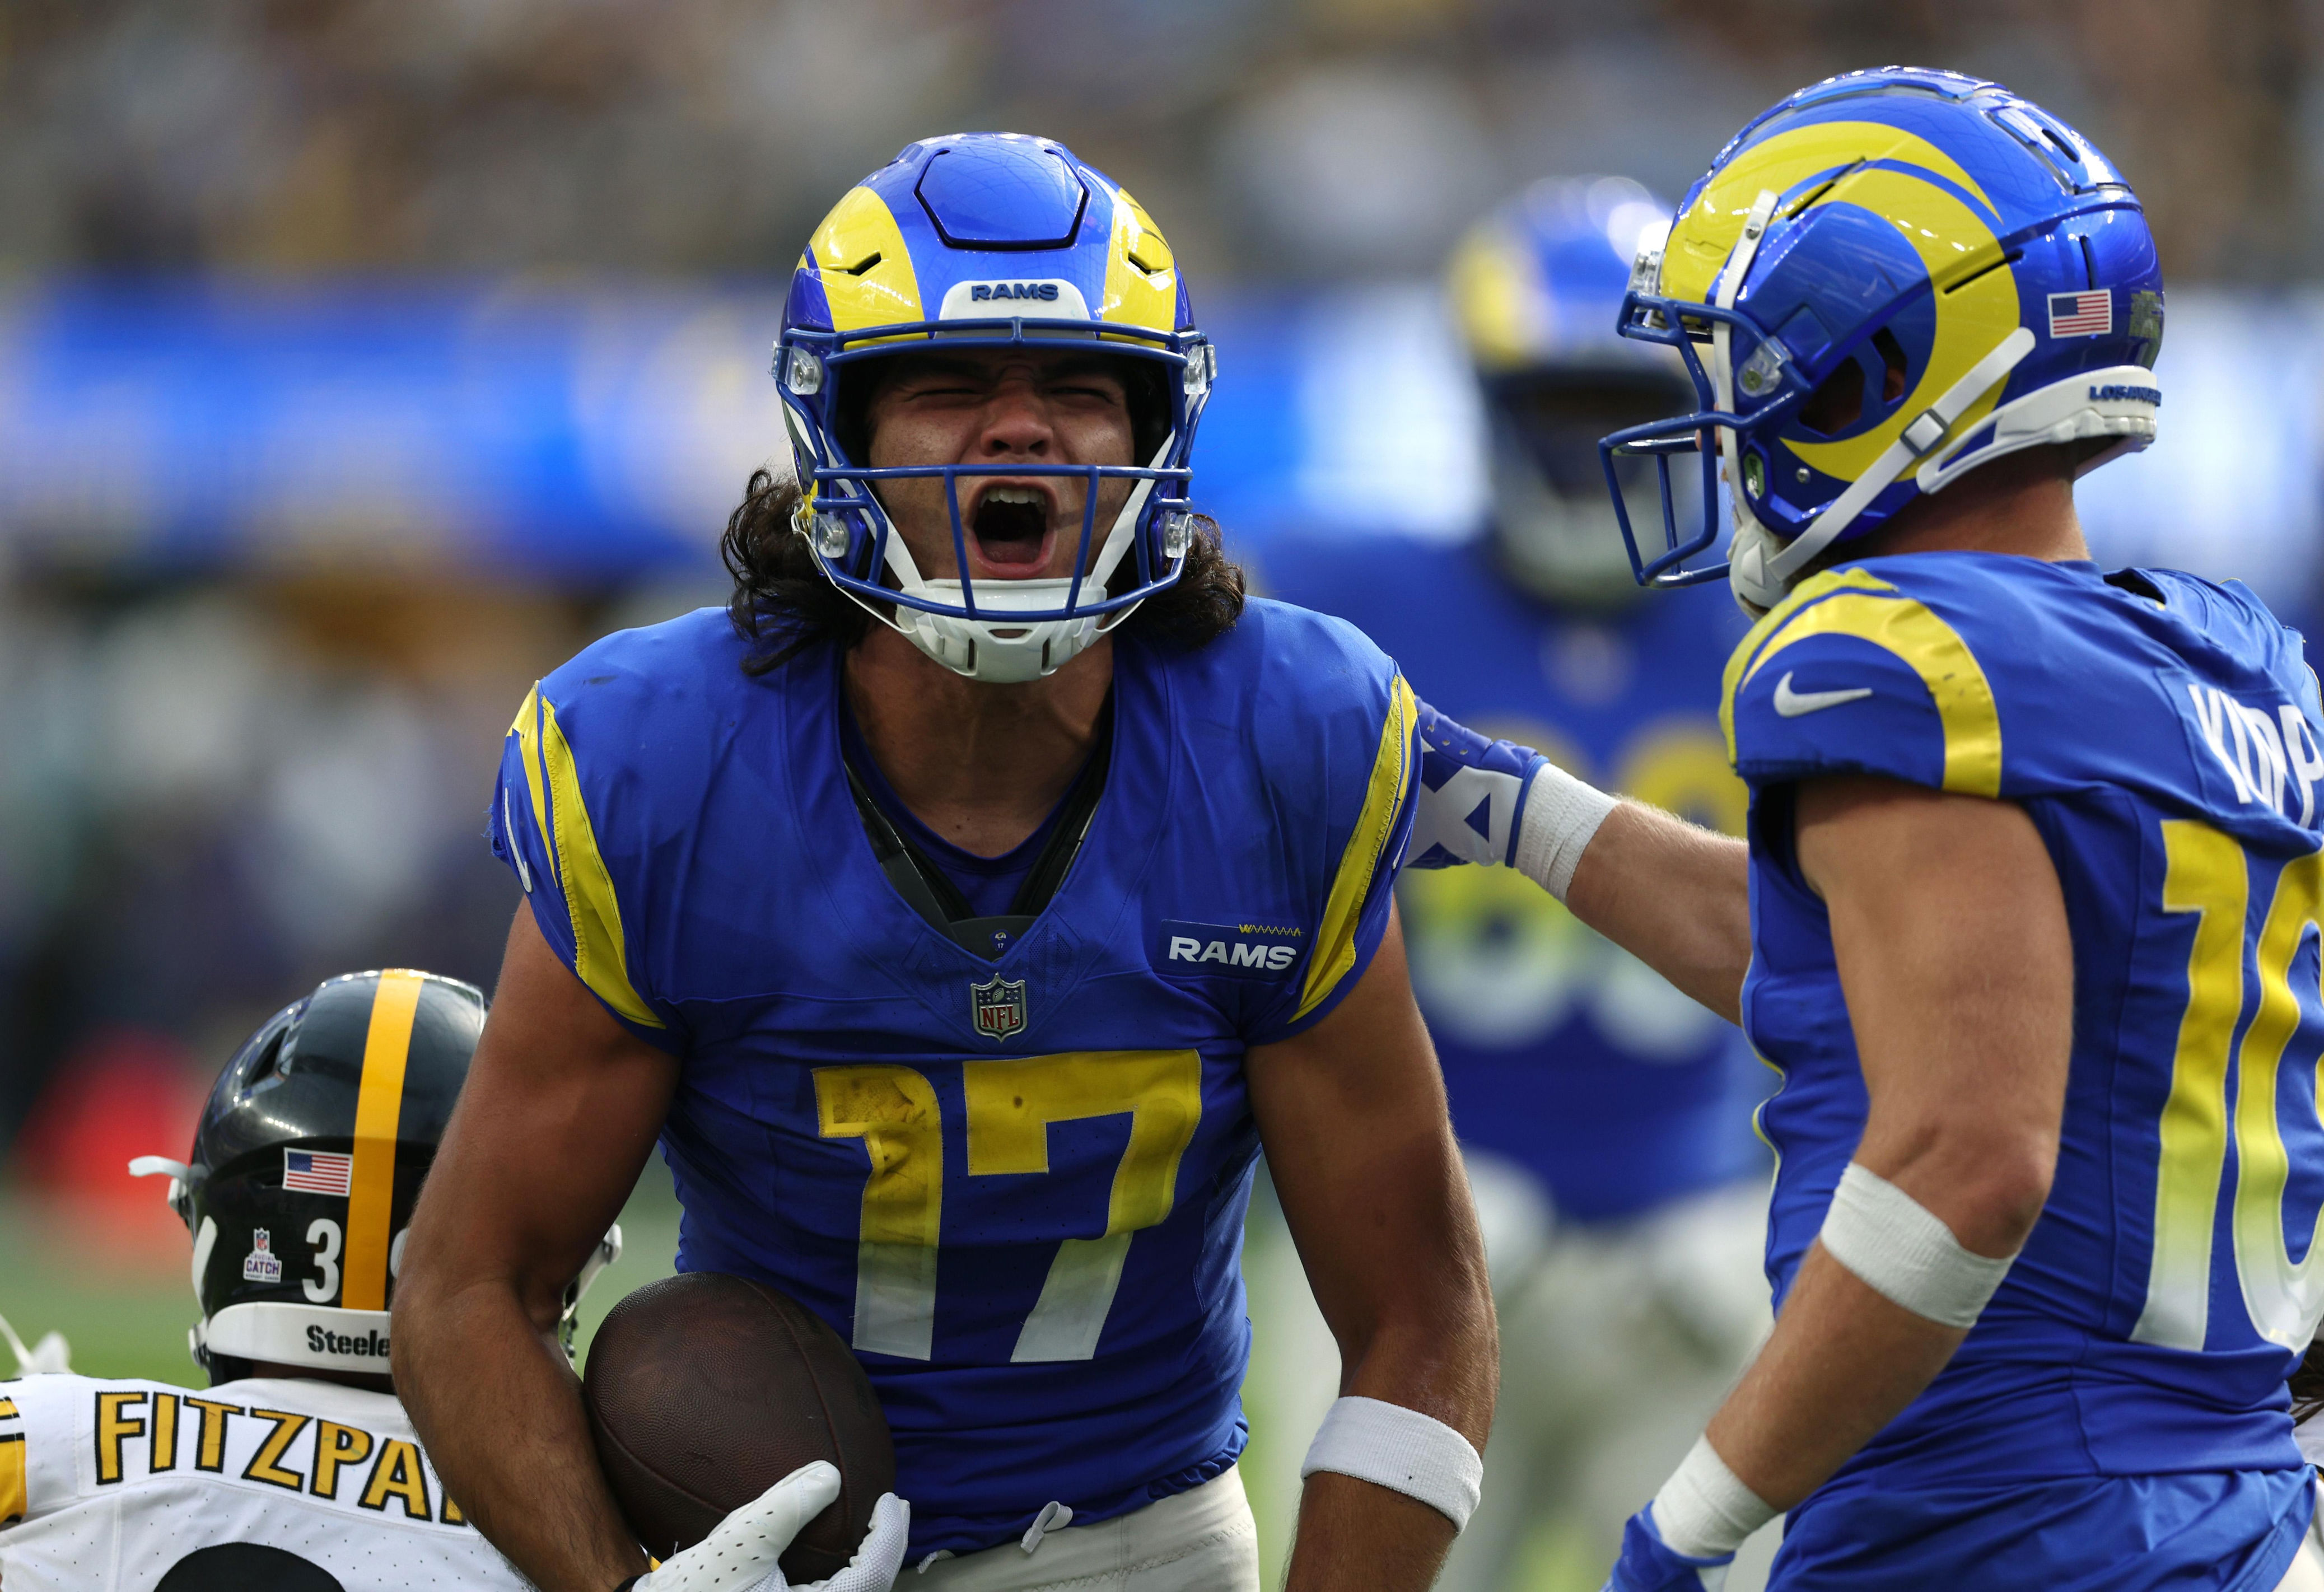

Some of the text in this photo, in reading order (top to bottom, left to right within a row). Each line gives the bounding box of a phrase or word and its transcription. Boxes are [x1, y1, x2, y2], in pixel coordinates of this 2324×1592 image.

[972, 283, 1059, 301] RAMS
[1169, 936, 1296, 970] RAMS
[981, 1005, 1019, 1030] NFL
[2129, 819, 2324, 1356] 10
[810, 1049, 1202, 1362] 17
[246, 1260, 279, 1274] CATCH
